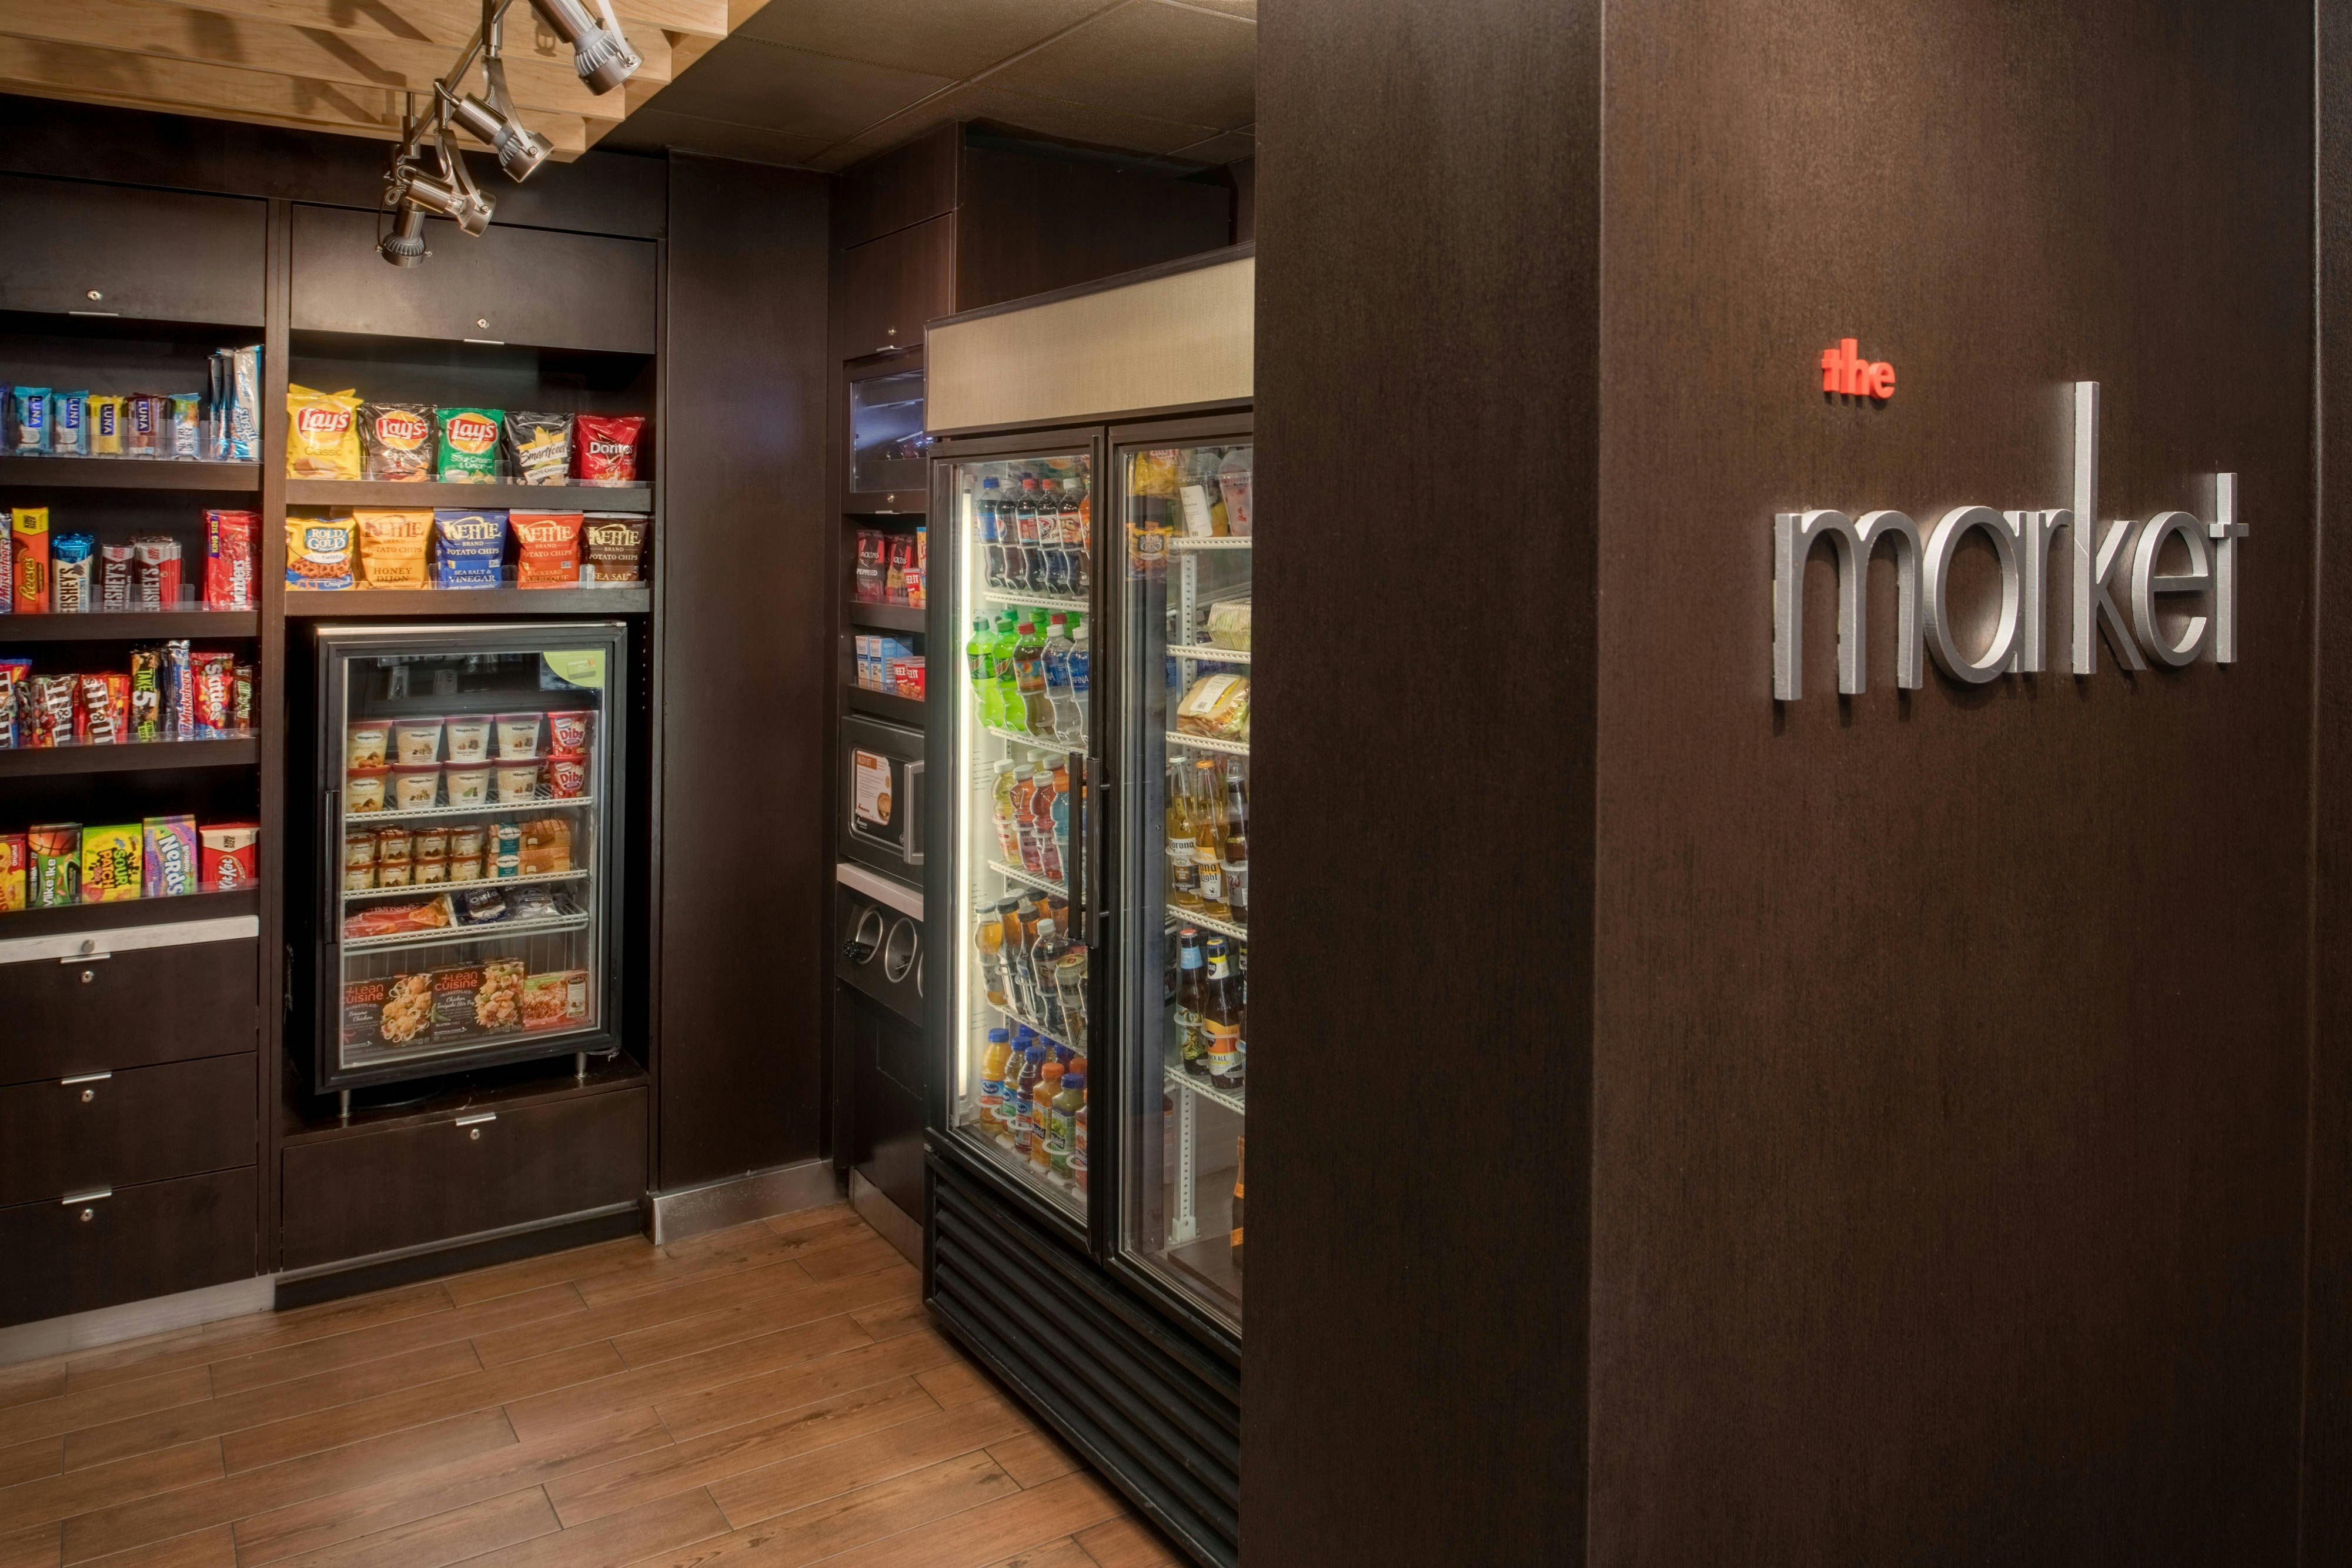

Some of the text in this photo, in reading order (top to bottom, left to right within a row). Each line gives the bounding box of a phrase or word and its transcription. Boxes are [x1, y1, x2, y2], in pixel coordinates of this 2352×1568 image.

[1821, 338, 1896, 400] the
[31, 397, 41, 425] LUNA
[69, 398, 79, 426] LUNA
[103, 406, 113, 433] LUNA
[138, 401, 148, 429] LUNA
[300, 407, 350, 432] Lay's
[382, 419, 423, 440] Lay's
[451, 420, 495, 442] Lay's
[305, 446, 343, 456] Classic
[451, 454, 493, 464] Sour Cream
[520, 442, 567, 464] Smartfood
[312, 529, 343, 539] ROLD
[365, 515, 425, 538] KETTLE
[442, 516, 502, 540] KETTLE
[516, 520, 574, 544] KETTLE
[587, 523, 642, 546] KETTLE
[307, 537, 346, 550] GOLD
[1773, 381, 2249, 701] market
[18, 556, 36, 601] Reese's
[373, 567, 413, 575] HONEY
[448, 575, 496, 583] VINEGAR
[521, 575, 569, 583] BARBEQUE
[592, 572, 610, 581] SEA
[856, 568, 878, 576] PEPPERED
[61, 567, 79, 613] ERSHEY'S
[103, 563, 127, 612] ERSHEY'S
[141, 568, 161, 611] ERSHEY'S
[132, 668, 157, 707] TAKE 5
[179, 669, 192, 726] Musketeers
[205, 664, 224, 720] Skittles
[560, 727, 584, 740] Dibs
[560, 771, 584, 784] Dibs
[99, 849, 115, 890] PATCH
[113, 848, 129, 885] SOUR
[1201, 872, 1218, 882] Light
[342, 992, 384, 1004] uisine
